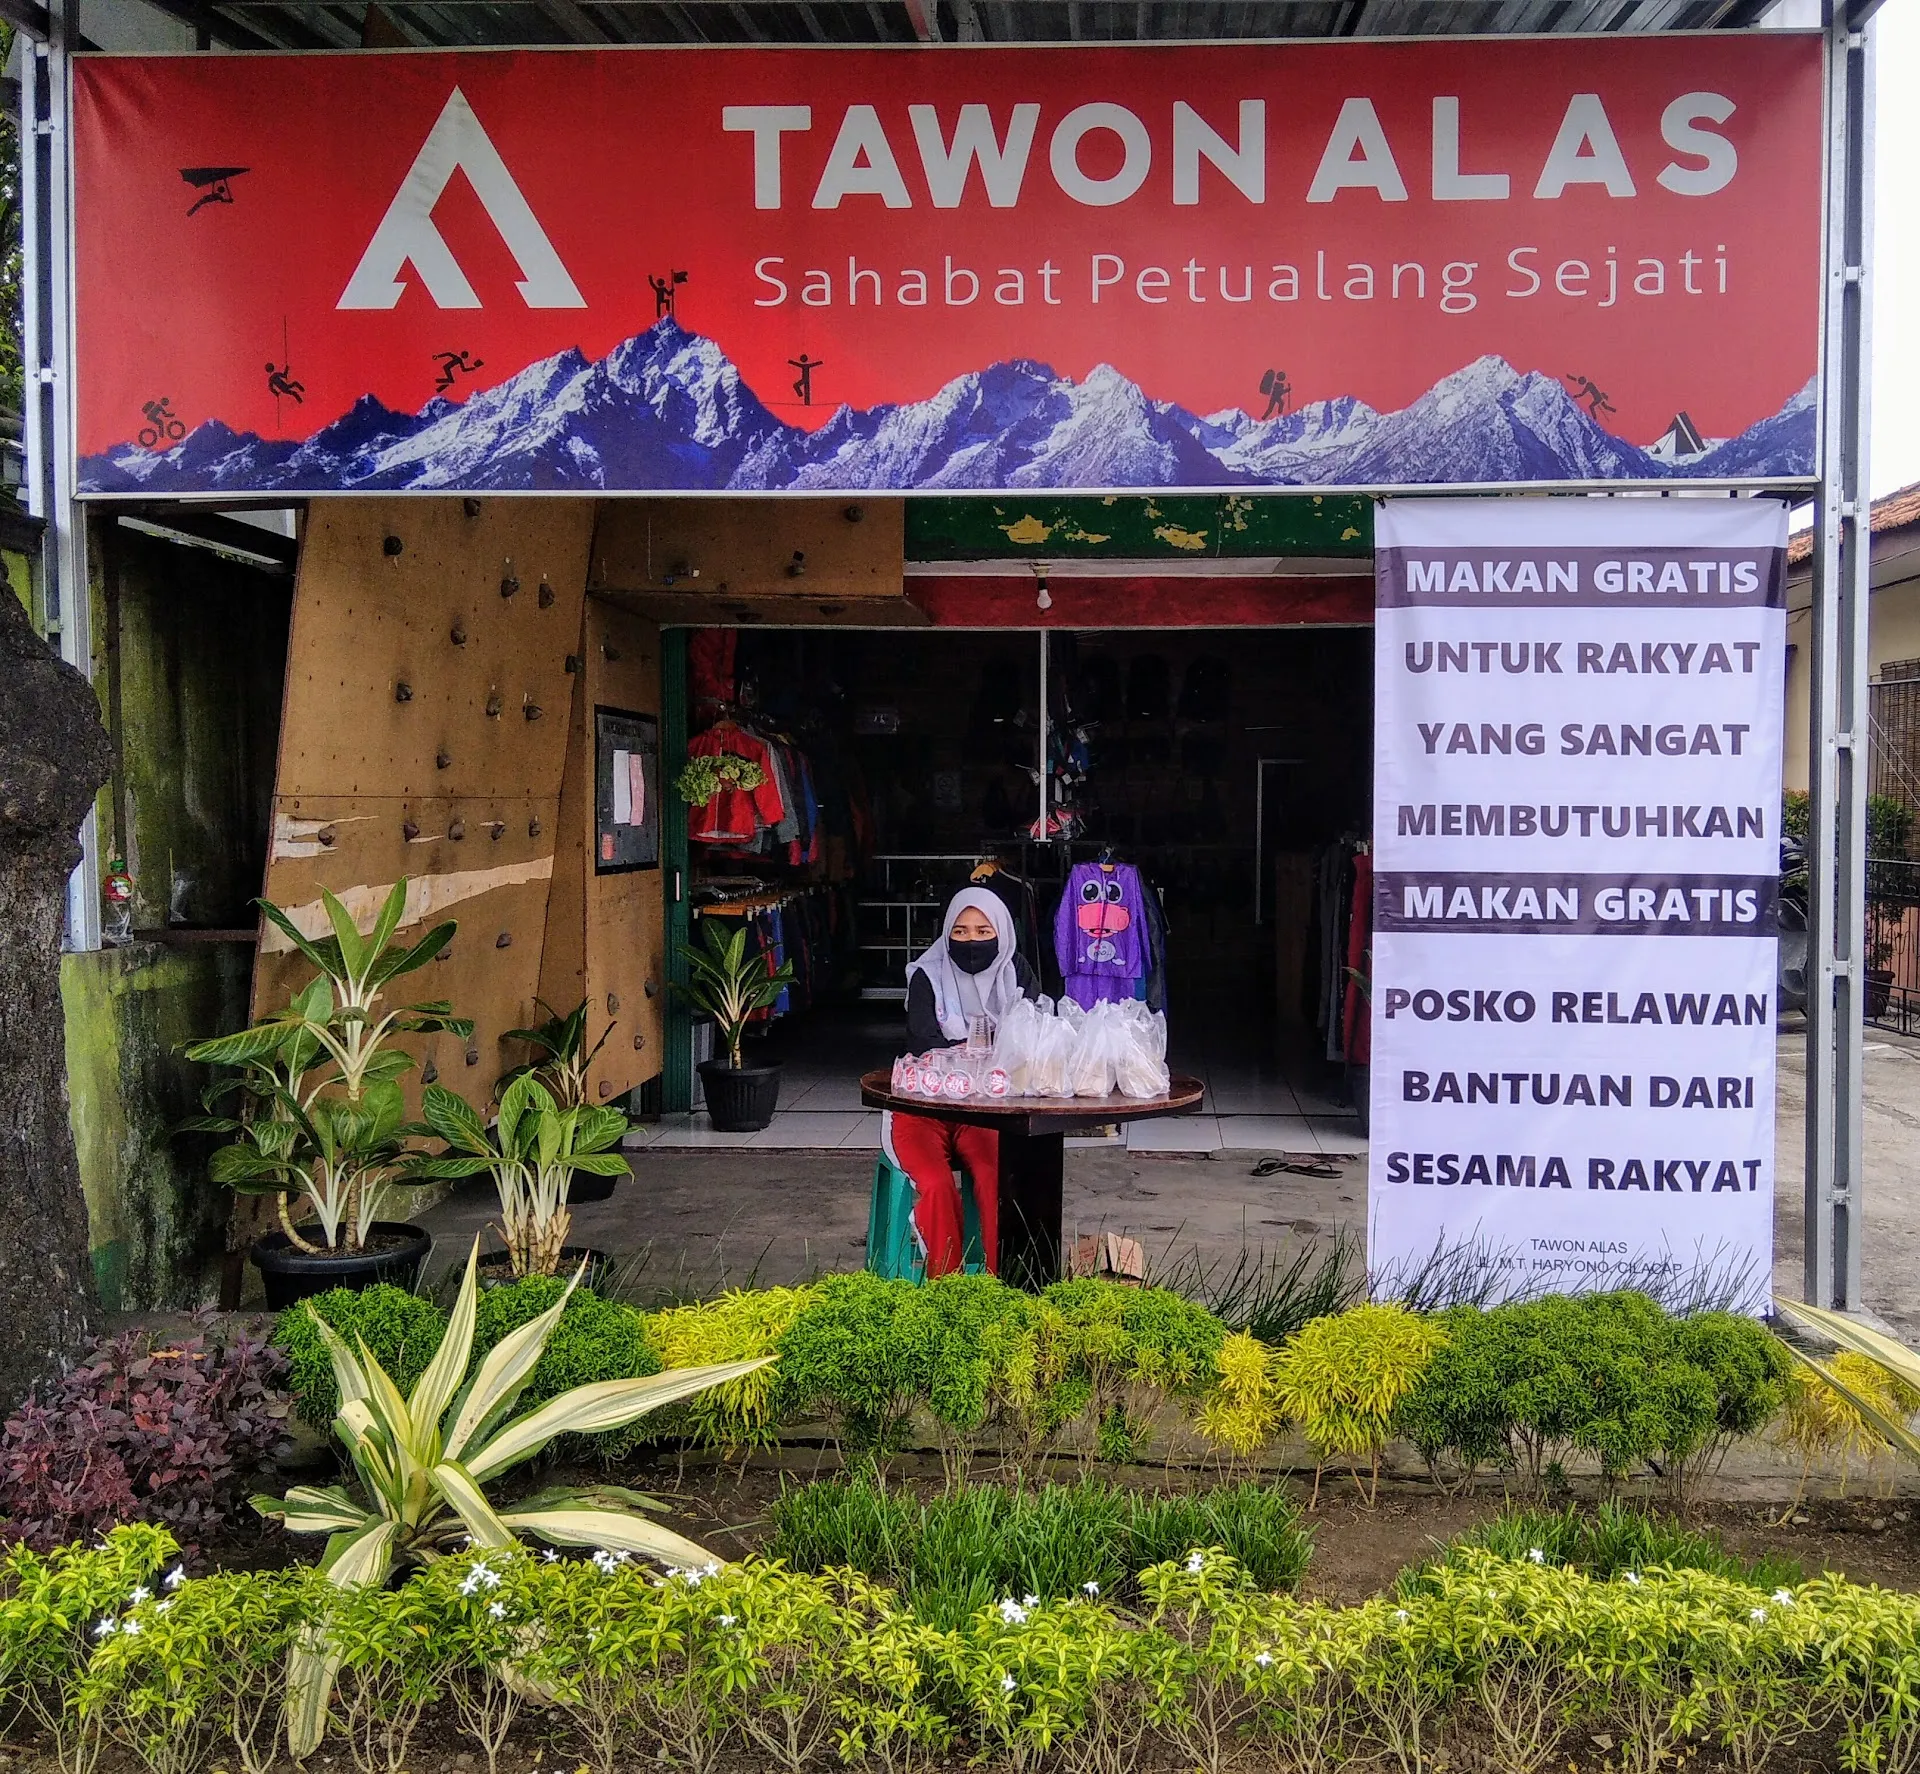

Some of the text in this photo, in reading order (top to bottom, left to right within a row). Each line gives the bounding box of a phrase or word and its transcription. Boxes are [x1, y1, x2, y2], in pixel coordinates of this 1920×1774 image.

[722, 92, 1738, 210] TAWON ALAS
[754, 242, 1729, 315] Sahabat Petualang Sejati
[1406, 560, 1759, 594] MAKAN GRATIS
[1405, 641, 1761, 674] UNTUK RAKYAT
[1416, 722, 1750, 756] YANG SANGAT
[1397, 804, 1764, 839] MEMBUTUHKAN
[1403, 886, 1758, 923] MAKAN GRATIS
[1385, 988, 1767, 1026] POSKO RELAWAN
[1403, 1070, 1754, 1109] BANTUAN DARI
[1386, 1151, 1762, 1193] SESAMA RAKYAT
[1530, 1238, 1628, 1254] TAWON ALAS
